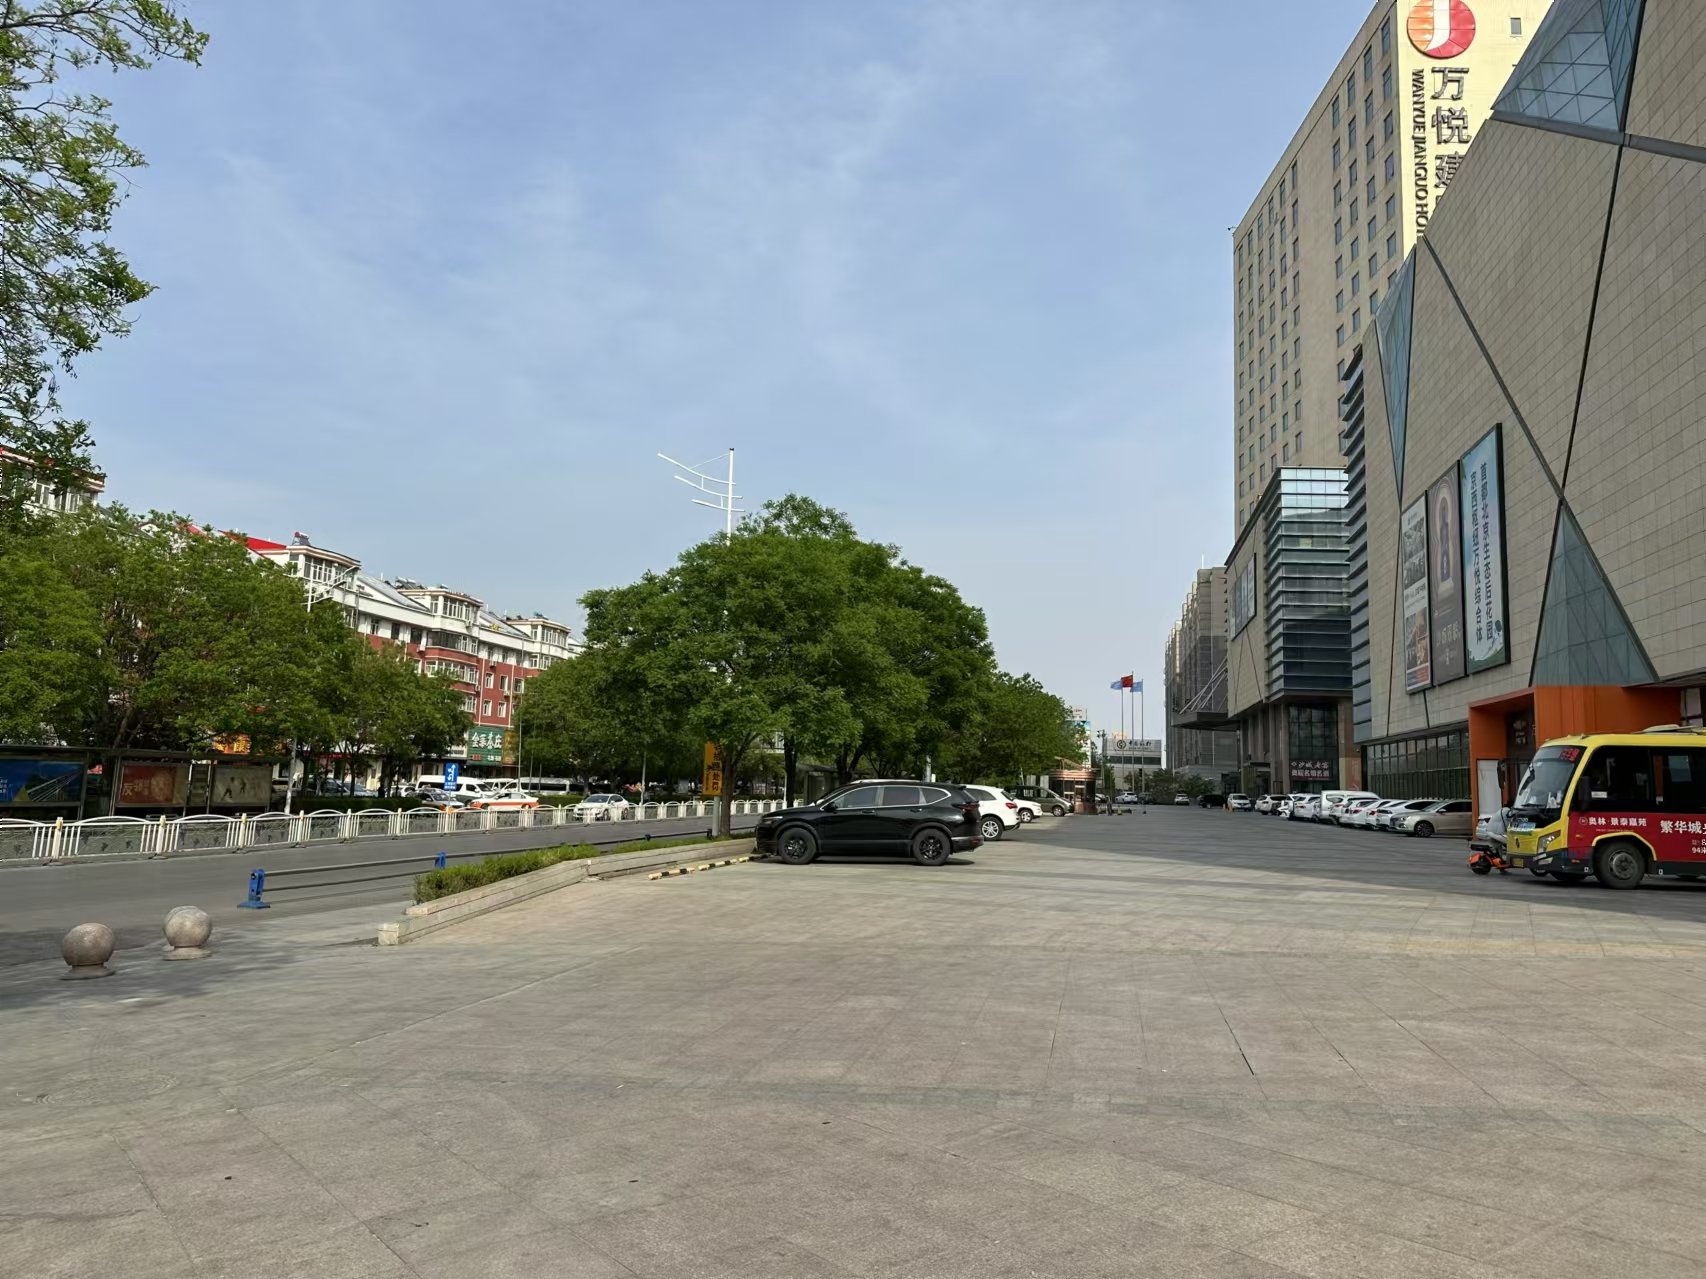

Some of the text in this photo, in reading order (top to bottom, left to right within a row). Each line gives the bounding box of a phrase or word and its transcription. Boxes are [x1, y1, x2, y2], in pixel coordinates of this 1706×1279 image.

[1411, 68, 1425, 134] WANYUE
[1411, 134, 1428, 201] JIANGUO
[1430, 66, 1472, 204] 万悦建
